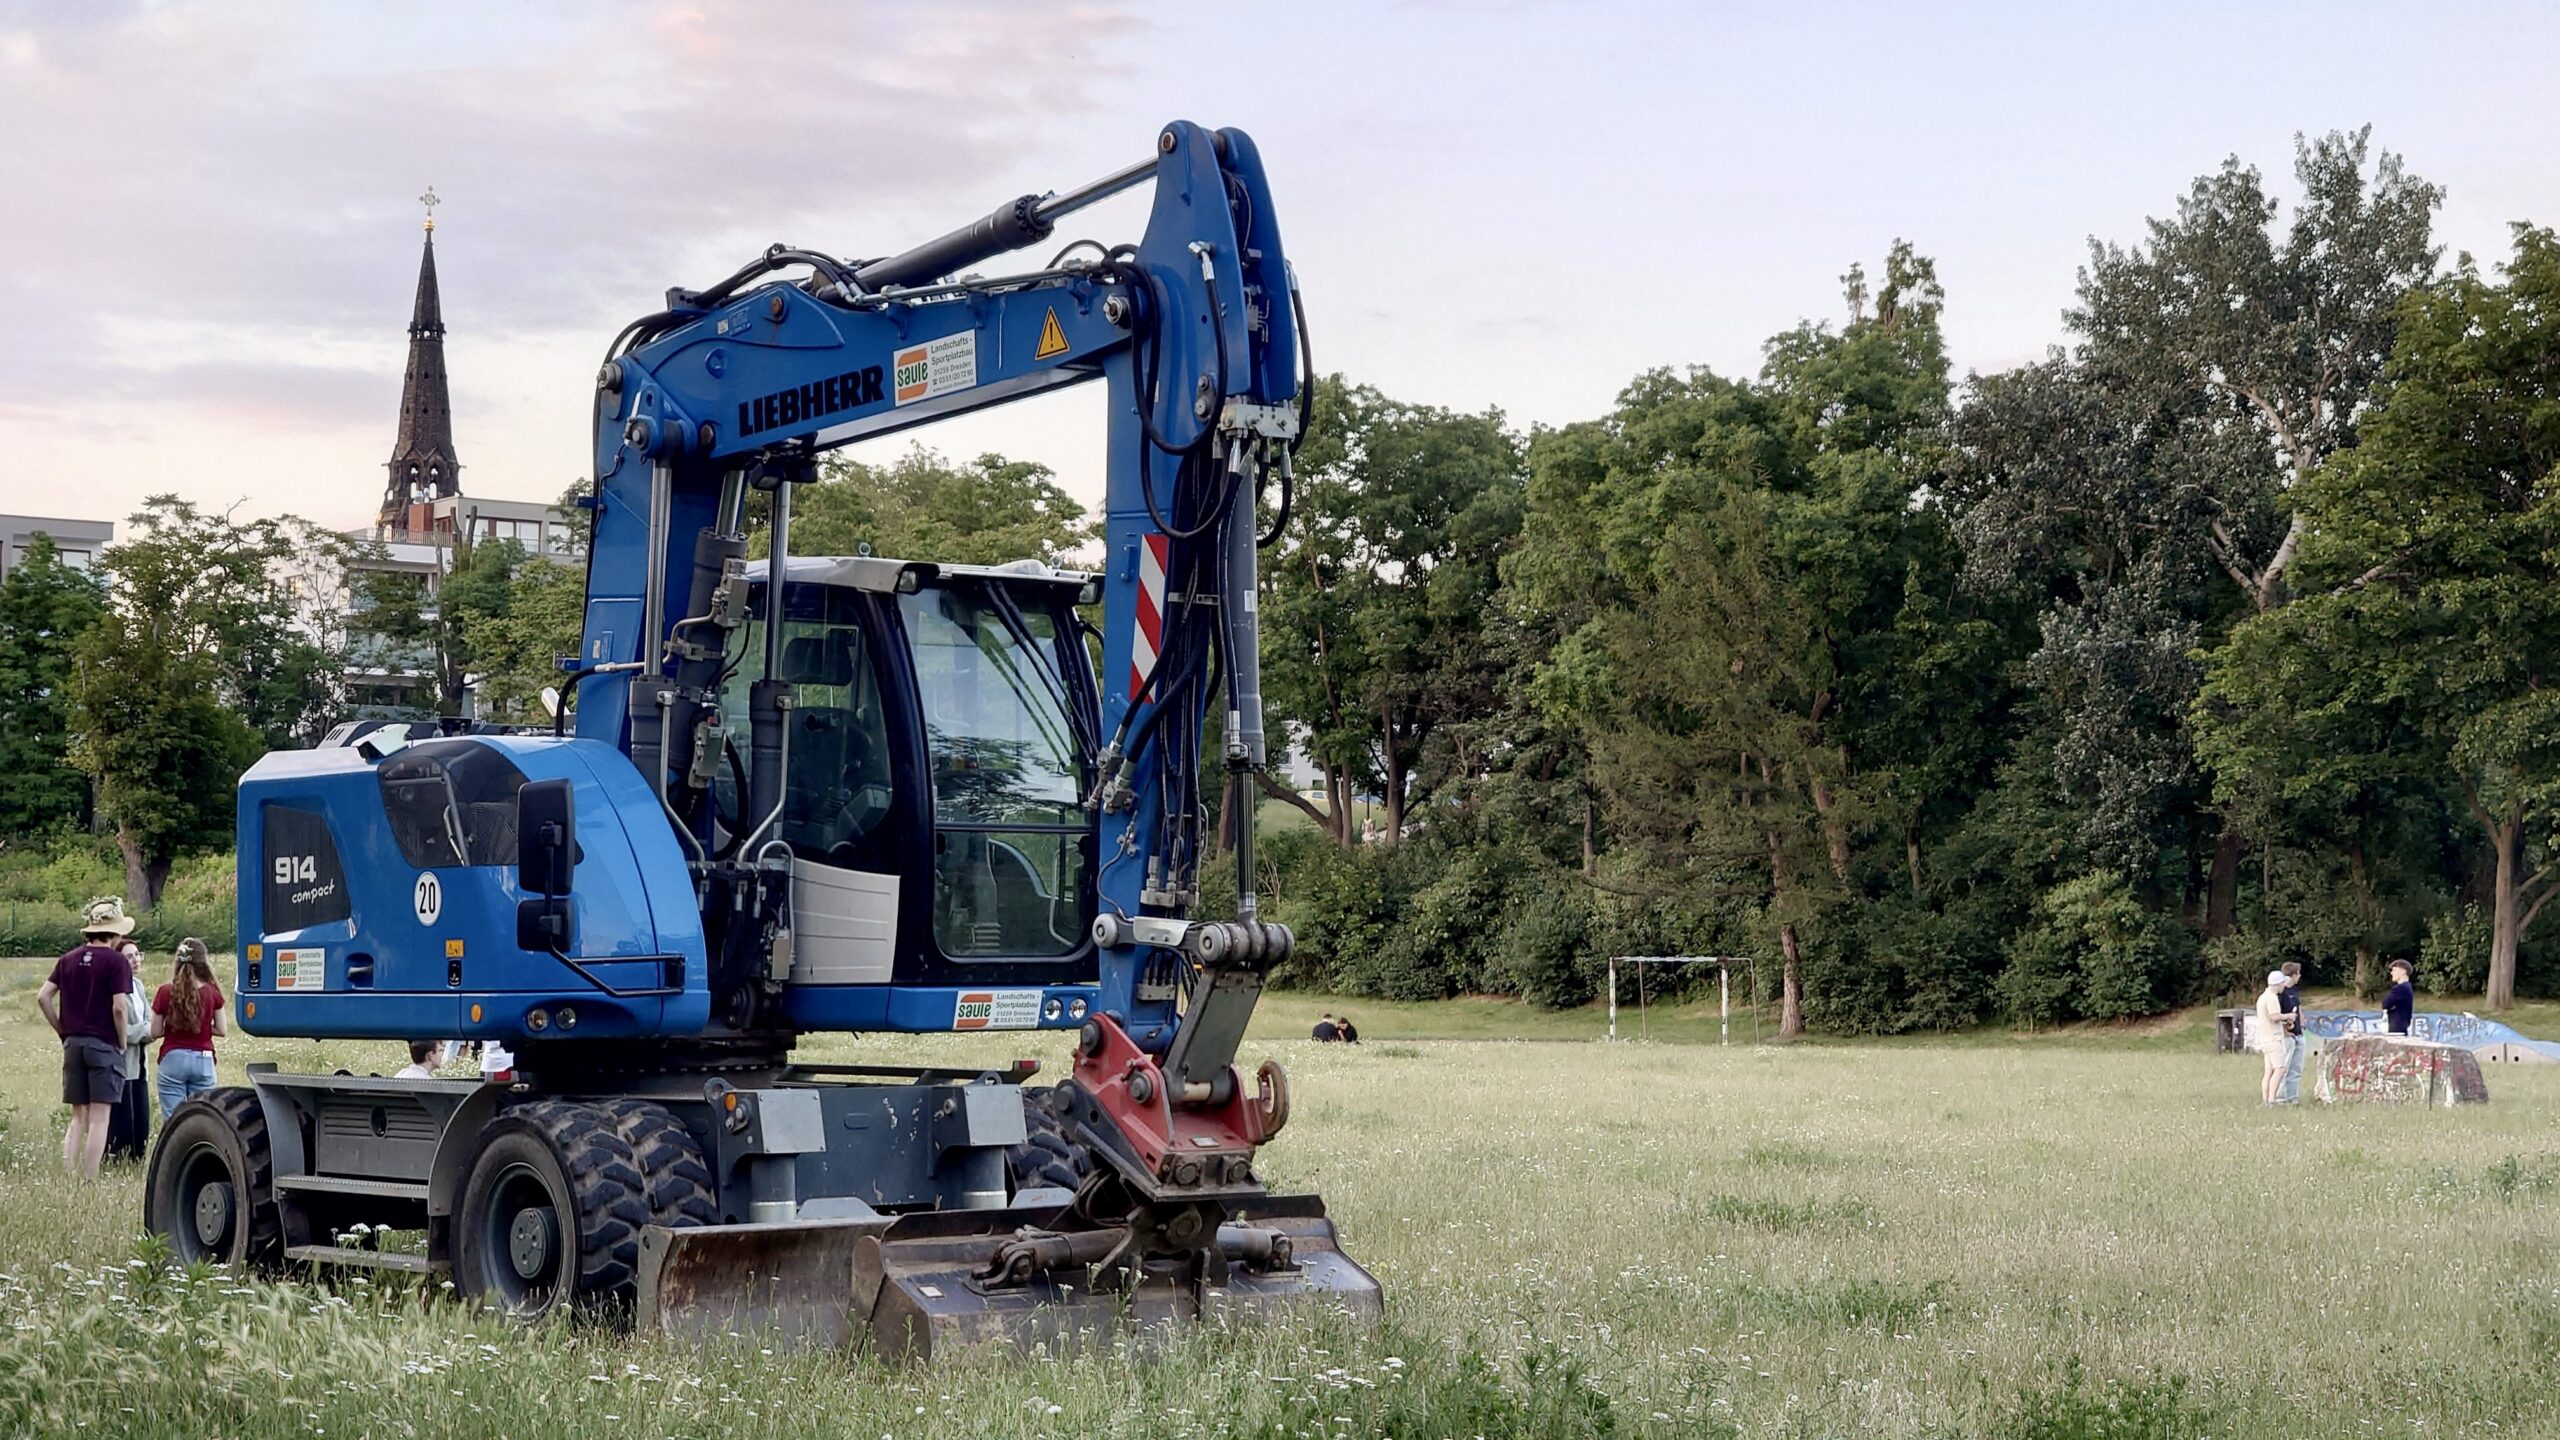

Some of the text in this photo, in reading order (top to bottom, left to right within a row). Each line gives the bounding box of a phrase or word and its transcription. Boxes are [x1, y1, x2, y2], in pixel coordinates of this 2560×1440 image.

[931, 348, 973, 367] Sportplatzbau
[950, 361, 972, 371] Dresden
[897, 362, 928, 387] saule
[738, 365, 885, 438] LIEBHERR
[275, 855, 317, 884] 914
[291, 878, 336, 904] compact
[419, 881, 436, 914] 20
[958, 1003, 992, 1018] saule
